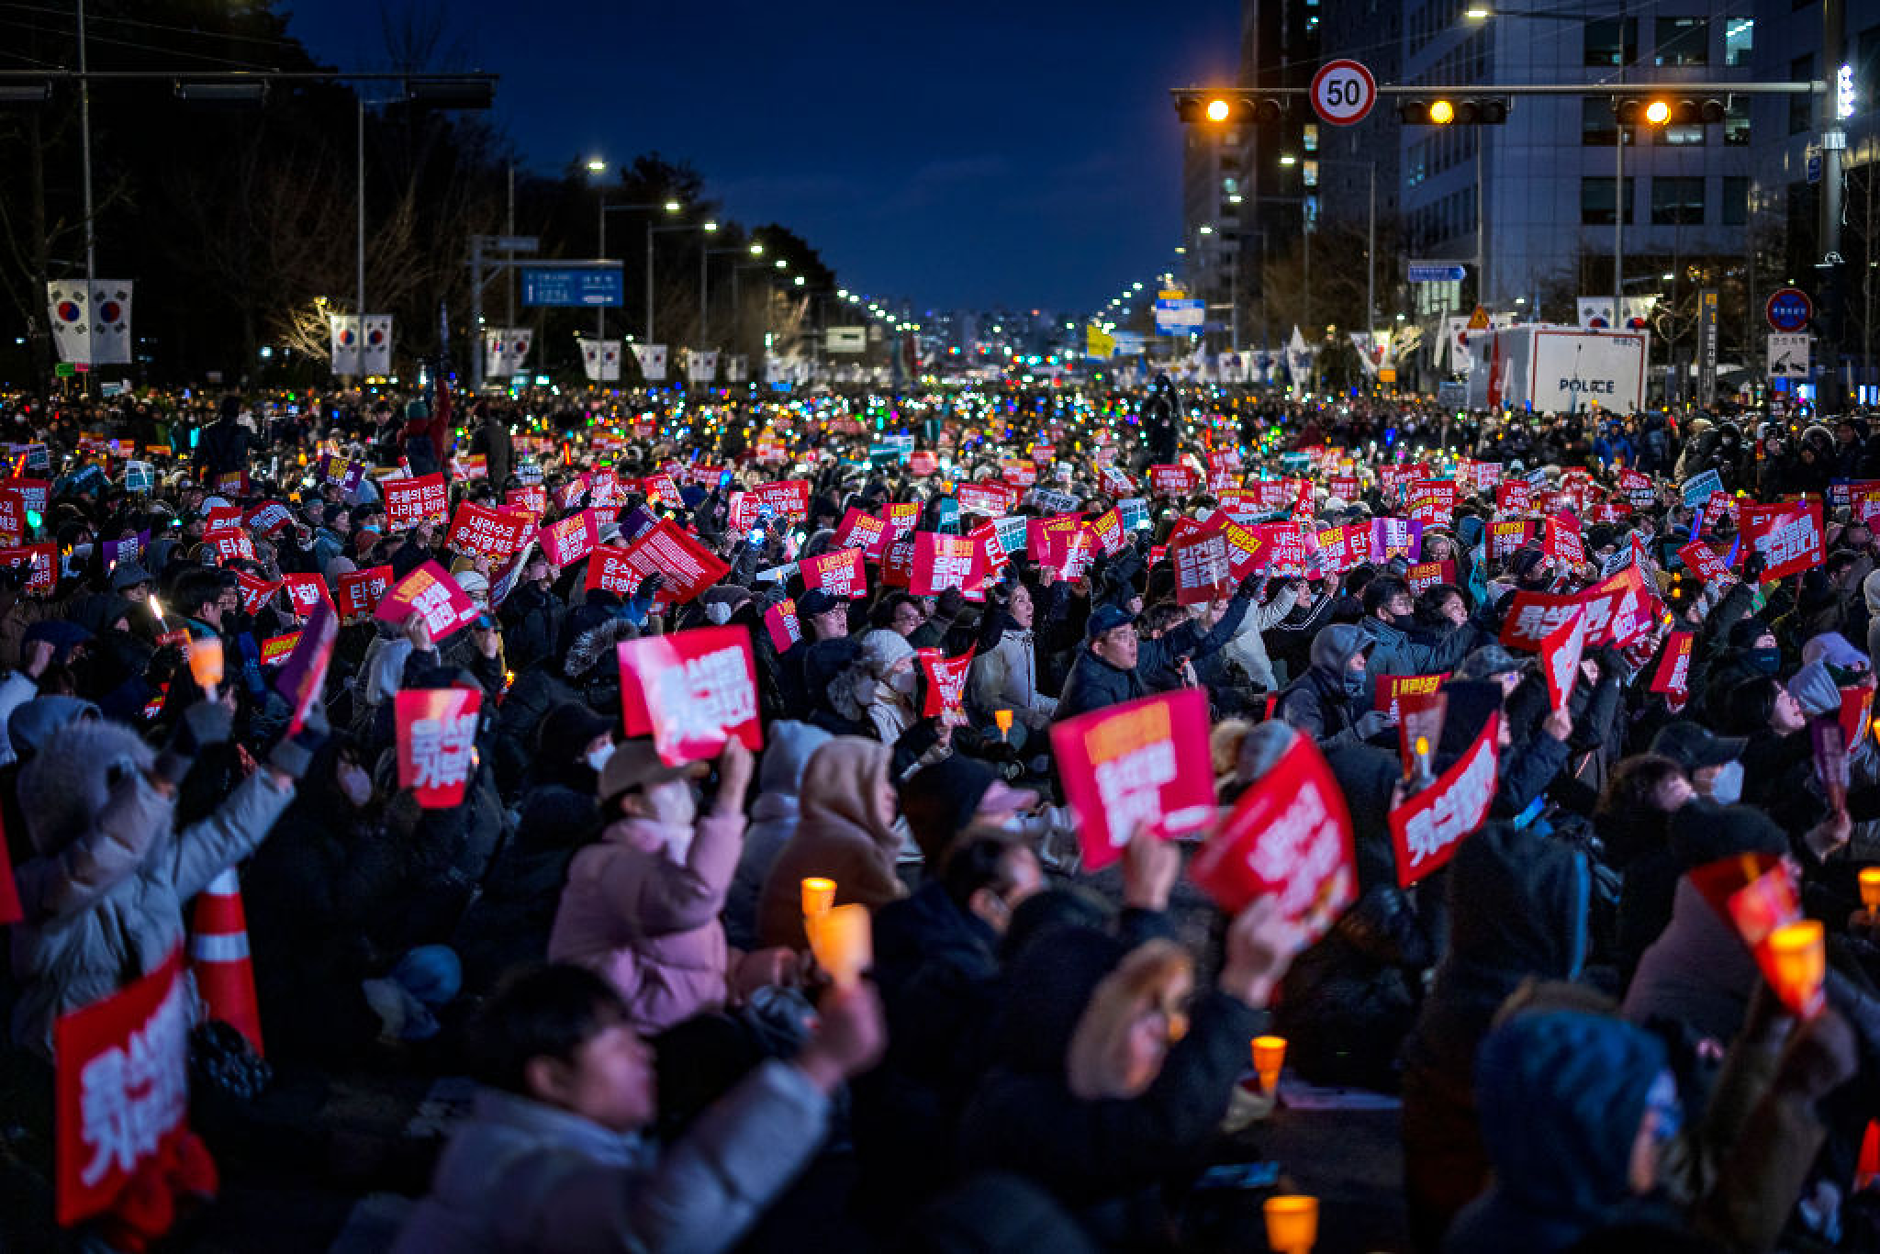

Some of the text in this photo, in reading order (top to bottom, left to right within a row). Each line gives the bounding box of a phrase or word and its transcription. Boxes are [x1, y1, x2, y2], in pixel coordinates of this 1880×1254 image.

[1327, 80, 1360, 106] 50
[1559, 378, 1615, 394] POLICE
[390, 502, 422, 516] 나라를
[351, 578, 386, 609] 탄핵
